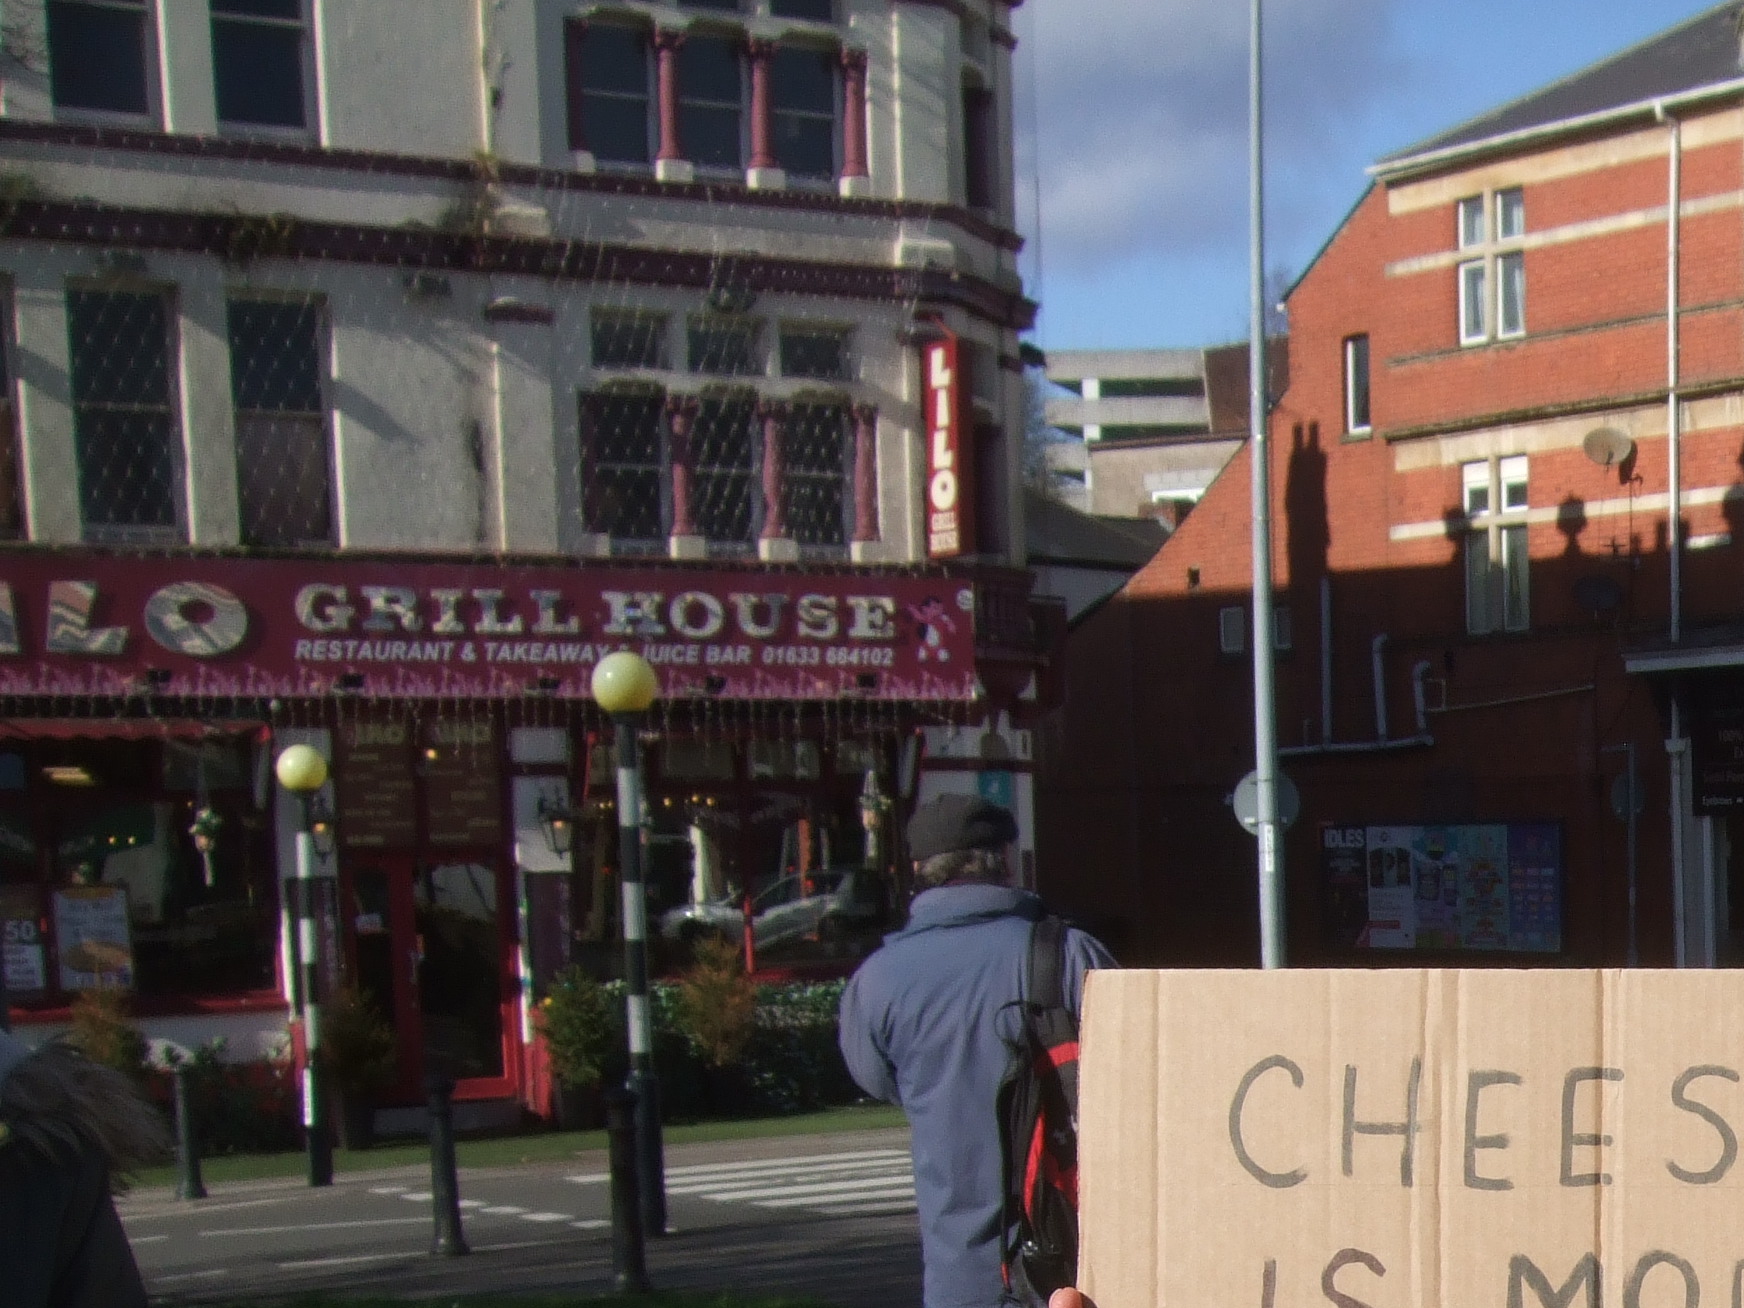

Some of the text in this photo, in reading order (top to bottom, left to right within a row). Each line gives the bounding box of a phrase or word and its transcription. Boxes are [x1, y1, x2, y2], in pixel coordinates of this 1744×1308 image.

[931, 347, 957, 510] LILO
[295, 583, 580, 634] GRILL
[602, 591, 896, 640] HOUSE
[294, 641, 454, 661] RESTAURANT
[460, 643, 477, 661] &
[485, 643, 610, 663] TAKEAWAY
[706, 645, 752, 664] BAR
[1324, 829, 1365, 848] IDLES
